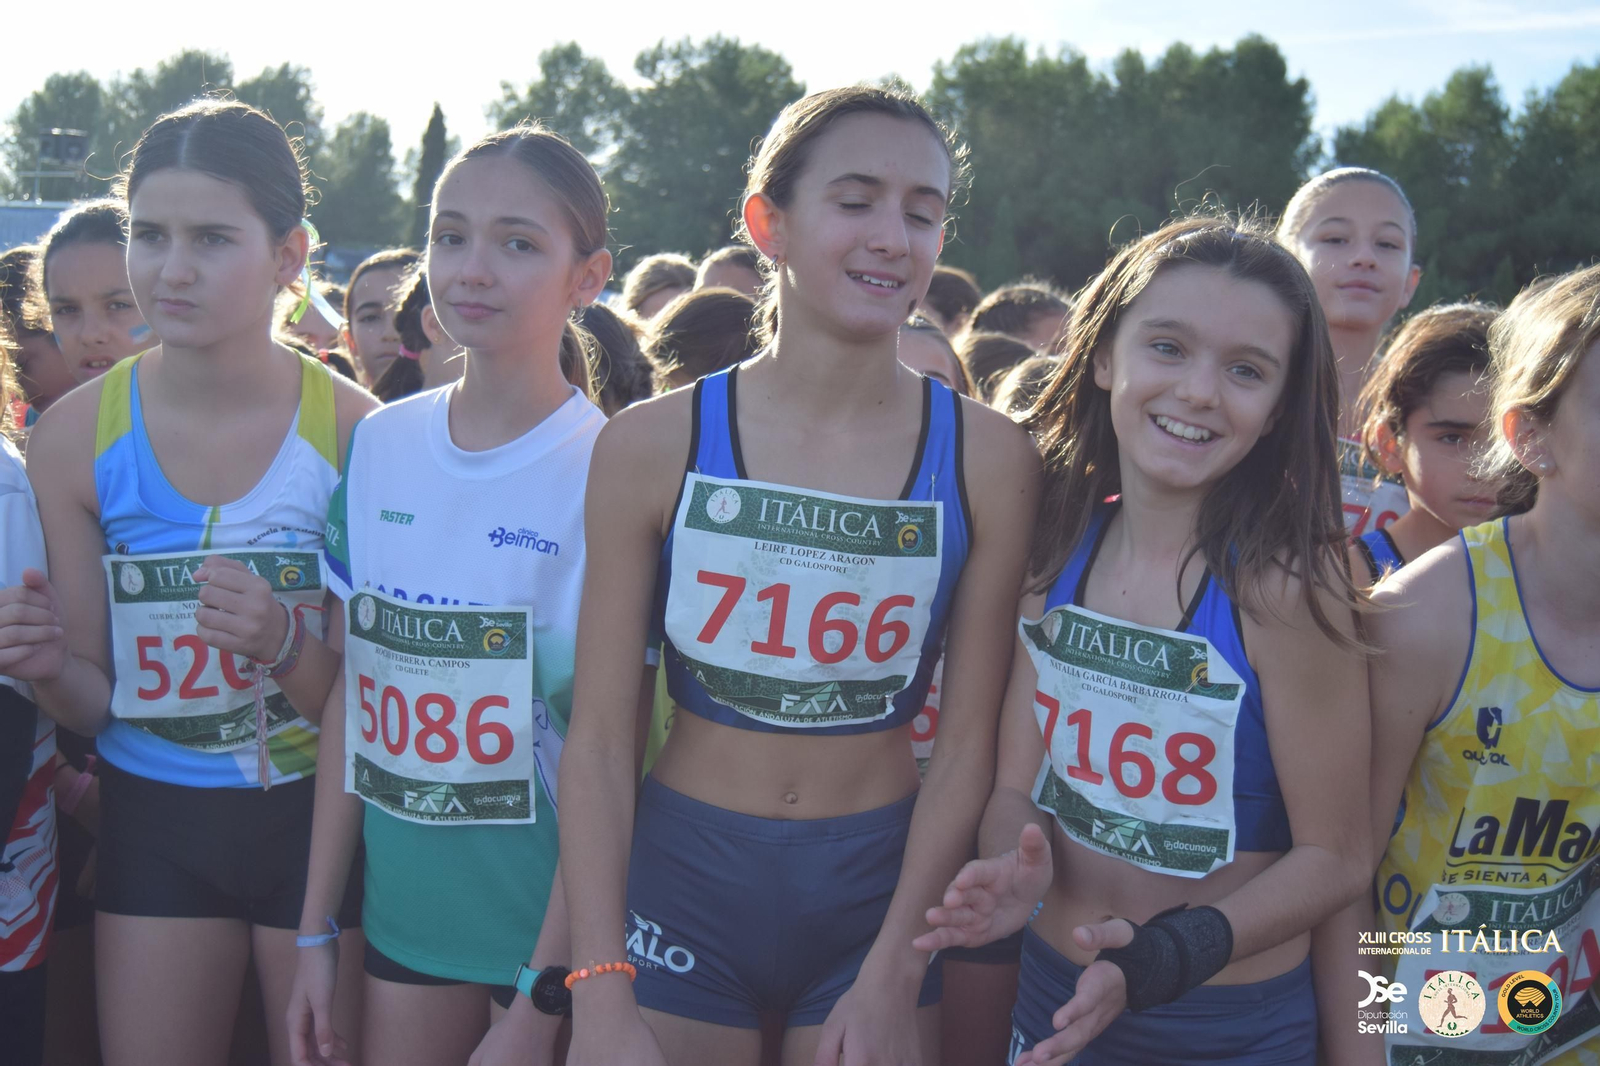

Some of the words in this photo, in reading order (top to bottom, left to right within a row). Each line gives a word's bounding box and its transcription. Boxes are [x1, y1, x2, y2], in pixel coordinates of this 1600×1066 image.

[380, 510, 415, 526] FASTER
[758, 497, 882, 539] ITÁLICA
[246, 527, 279, 546] Escuela
[757, 524, 819, 539] INTERNATIONAL
[821, 533, 844, 543] CROSS
[846, 536, 882, 546] COUNTRY
[754, 541, 787, 555] LEIRE
[790, 546, 826, 560] LOPEZ
[828, 553, 876, 567] ARAGON
[779, 558, 792, 567] CD
[794, 560, 848, 574] GALOSPORT
[381, 608, 464, 643] ITÁLICA
[697, 570, 915, 664] 7166
[1065, 621, 1172, 671] ITÁLICA
[391, 653, 427, 667] FERRERA
[428, 659, 471, 669] CAMPOS
[395, 664, 403, 672] CD
[404, 666, 430, 676] GILETE
[1065, 647, 1115, 665] INTERNATIONAL
[1116, 659, 1137, 671] CROSS
[1137, 665, 1172, 680] COUNTRY
[1050, 660, 1081, 678] NATALIA
[1119, 680, 1189, 704] BARBARROJA
[1081, 683, 1092, 692] CD
[1092, 685, 1138, 704] GALOSPORT
[358, 673, 515, 765] 5086
[759, 711, 800, 723] ANDALUZA
[815, 714, 854, 723] ATLETISMO
[1035, 689, 1218, 806] 7168
[434, 814, 475, 822] ATLETISMO
[1173, 840, 1217, 853] docunova
[1122, 853, 1161, 867] ATLETISMO
[1463, 869, 1530, 883] SIENTA
[1536, 872, 1548, 886] A
[1489, 879, 1583, 923] ITÁLICA
[627, 954, 659, 971] SPORT
